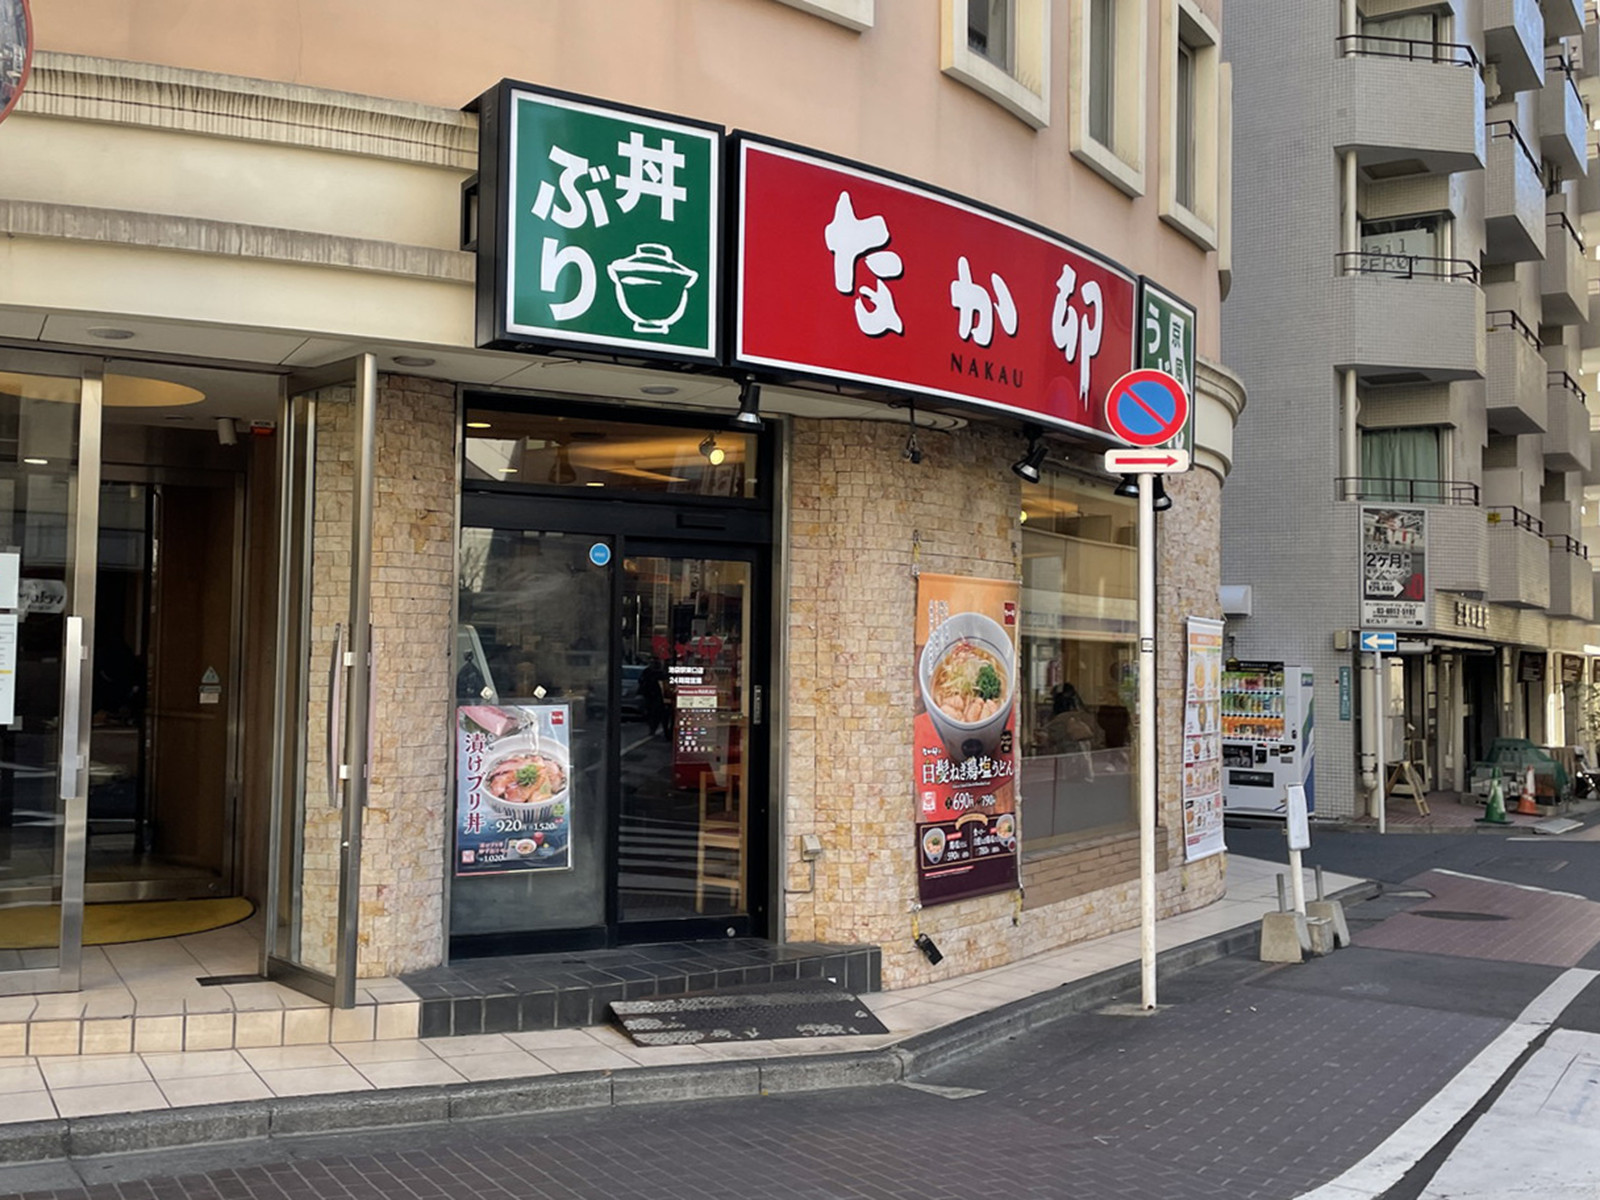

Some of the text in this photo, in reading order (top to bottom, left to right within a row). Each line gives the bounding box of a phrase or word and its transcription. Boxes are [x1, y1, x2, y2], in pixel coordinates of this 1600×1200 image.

[823, 190, 1104, 409] なか卯
[950, 353, 1024, 390] NAKAU
[464, 732, 488, 835] 漬けブリ丼
